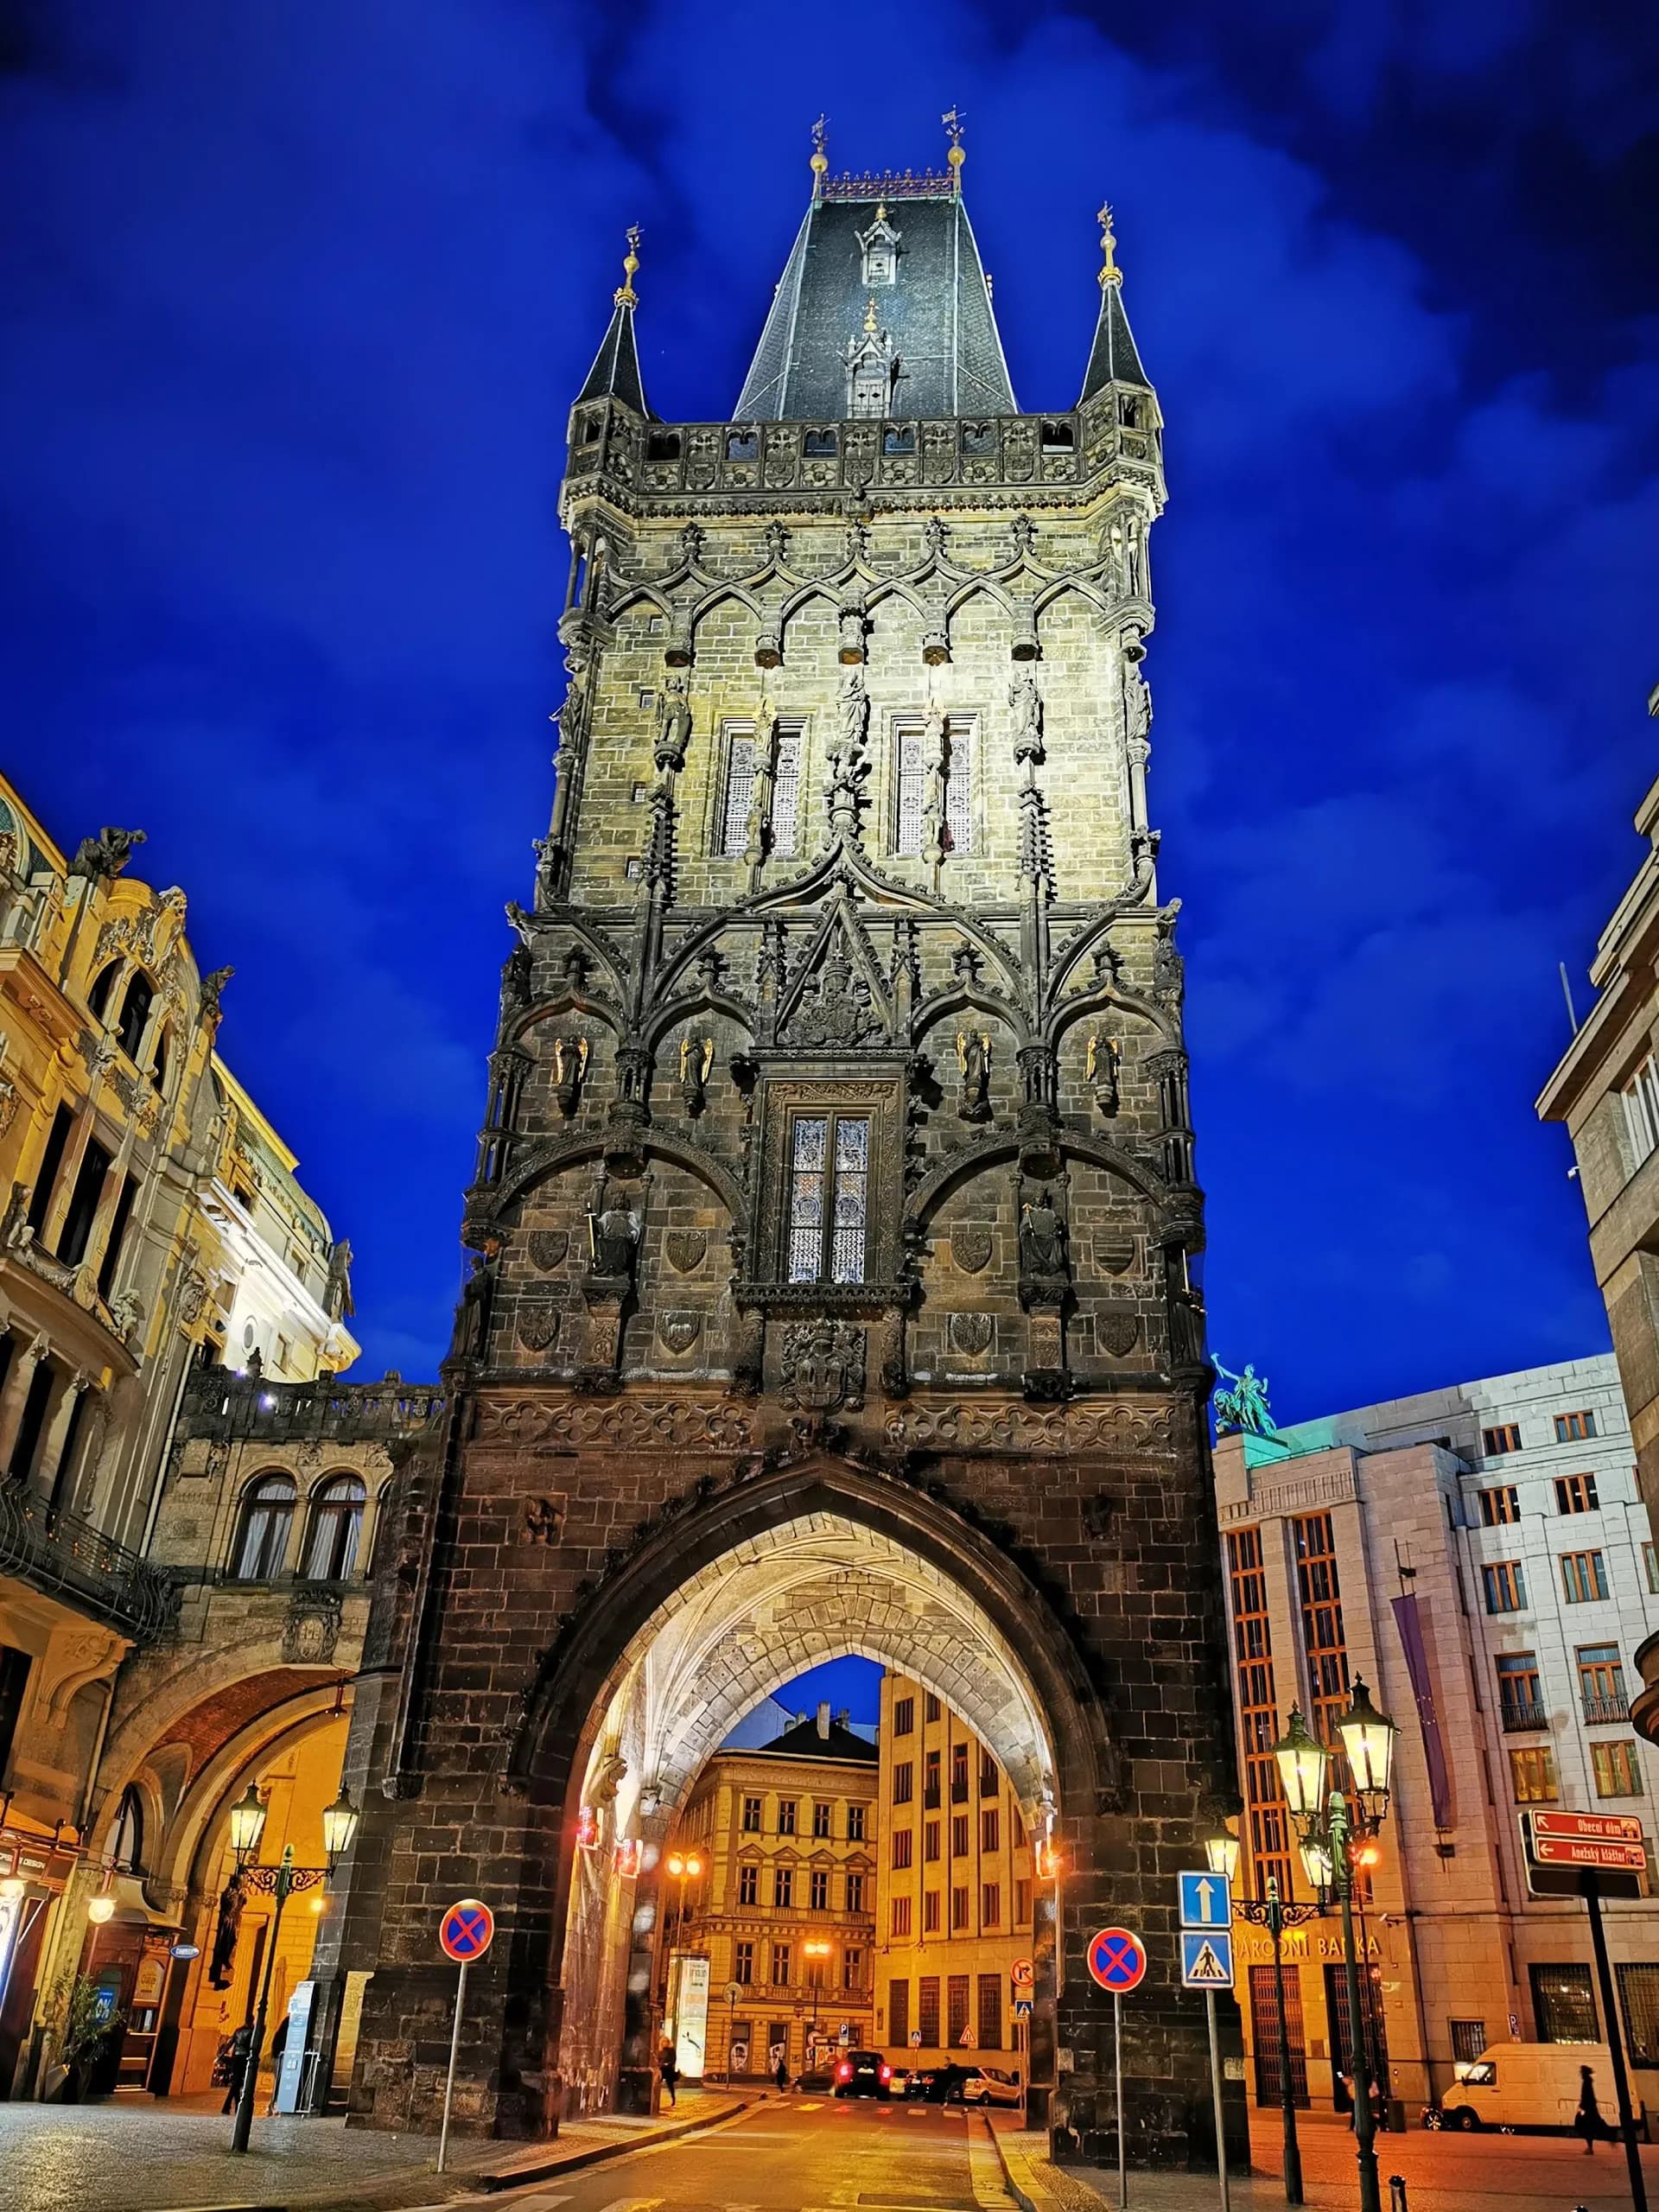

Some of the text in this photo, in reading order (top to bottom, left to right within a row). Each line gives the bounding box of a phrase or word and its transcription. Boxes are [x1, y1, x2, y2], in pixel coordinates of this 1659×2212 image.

[1578, 1819, 1621, 1834] Obecní dům
[1571, 1846, 1625, 1864] Anežský klášter
[841, 2024, 846, 2033] P
